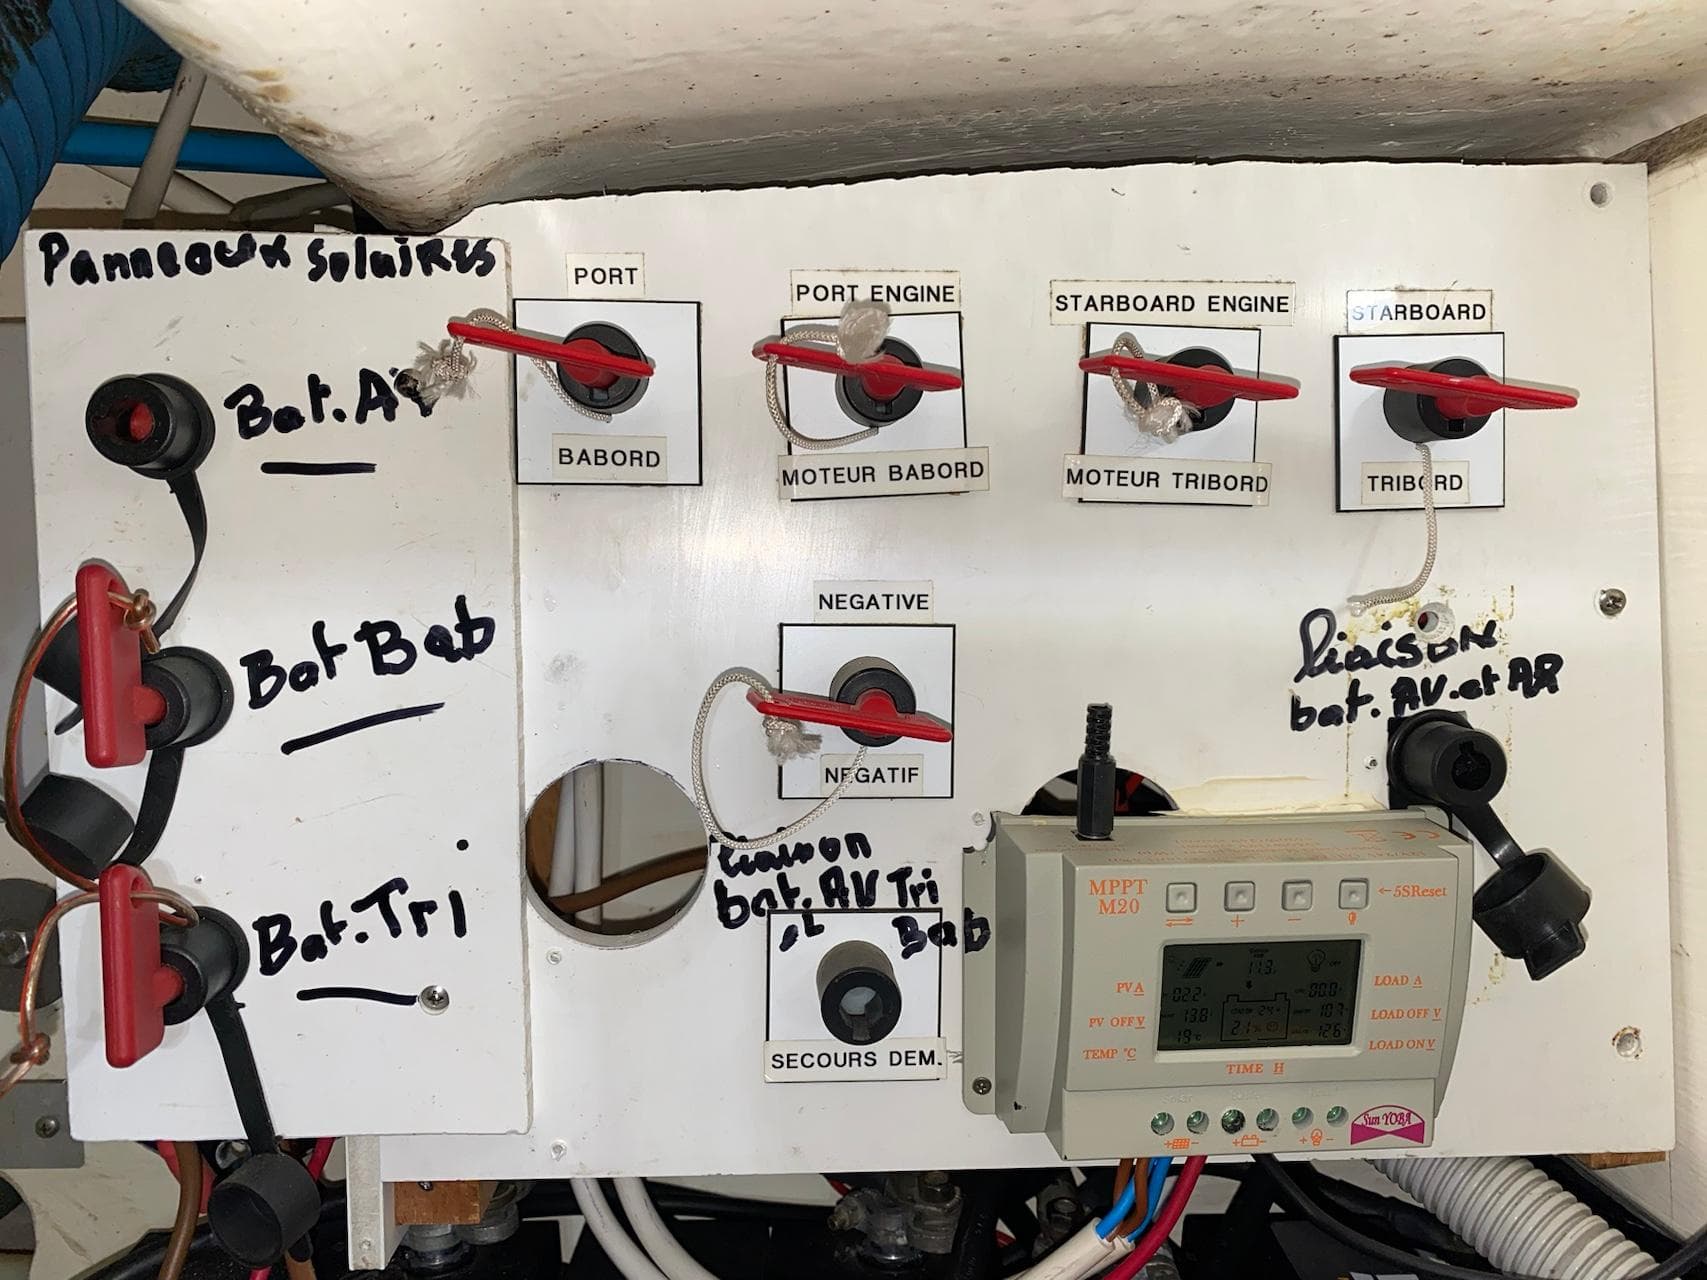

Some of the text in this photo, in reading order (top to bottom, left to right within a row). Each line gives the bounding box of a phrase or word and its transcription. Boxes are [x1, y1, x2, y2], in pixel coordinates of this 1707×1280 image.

[574, 267, 639, 286] PORT
[796, 284, 956, 303] PORT ENGINE
[1055, 294, 1290, 314] STARBOARD ENGINE
[1351, 303, 1487, 322] STARBOARD
[558, 448, 661, 469] BABORD
[782, 460, 985, 487] MOTEUR BABORD
[1066, 468, 1269, 494] MOTEUR TRIBORD
[818, 593, 929, 611] NEGATIVE
[354, 595, 496, 676] Bab
[825, 767, 919, 784] NEGATIF
[1089, 879, 1148, 896] MPPT
[1099, 899, 1140, 915] M20
[1374, 975, 1423, 988] LOAD A
[1089, 1016, 1104, 1028] PV
[1110, 1016, 1134, 1027] OFF
[1370, 1008, 1404, 1020] LOAD
[1406, 1008, 1429, 1019] OFF
[1368, 1040, 1403, 1050] LOAD
[1406, 1039, 1425, 1050] ON
[771, 1050, 943, 1070] SECOURS DEM.
[1083, 1048, 1118, 1060] TEMP
[1226, 1062, 1284, 1075] TIME H
[1361, 1111, 1412, 1127] Sun YOBA
